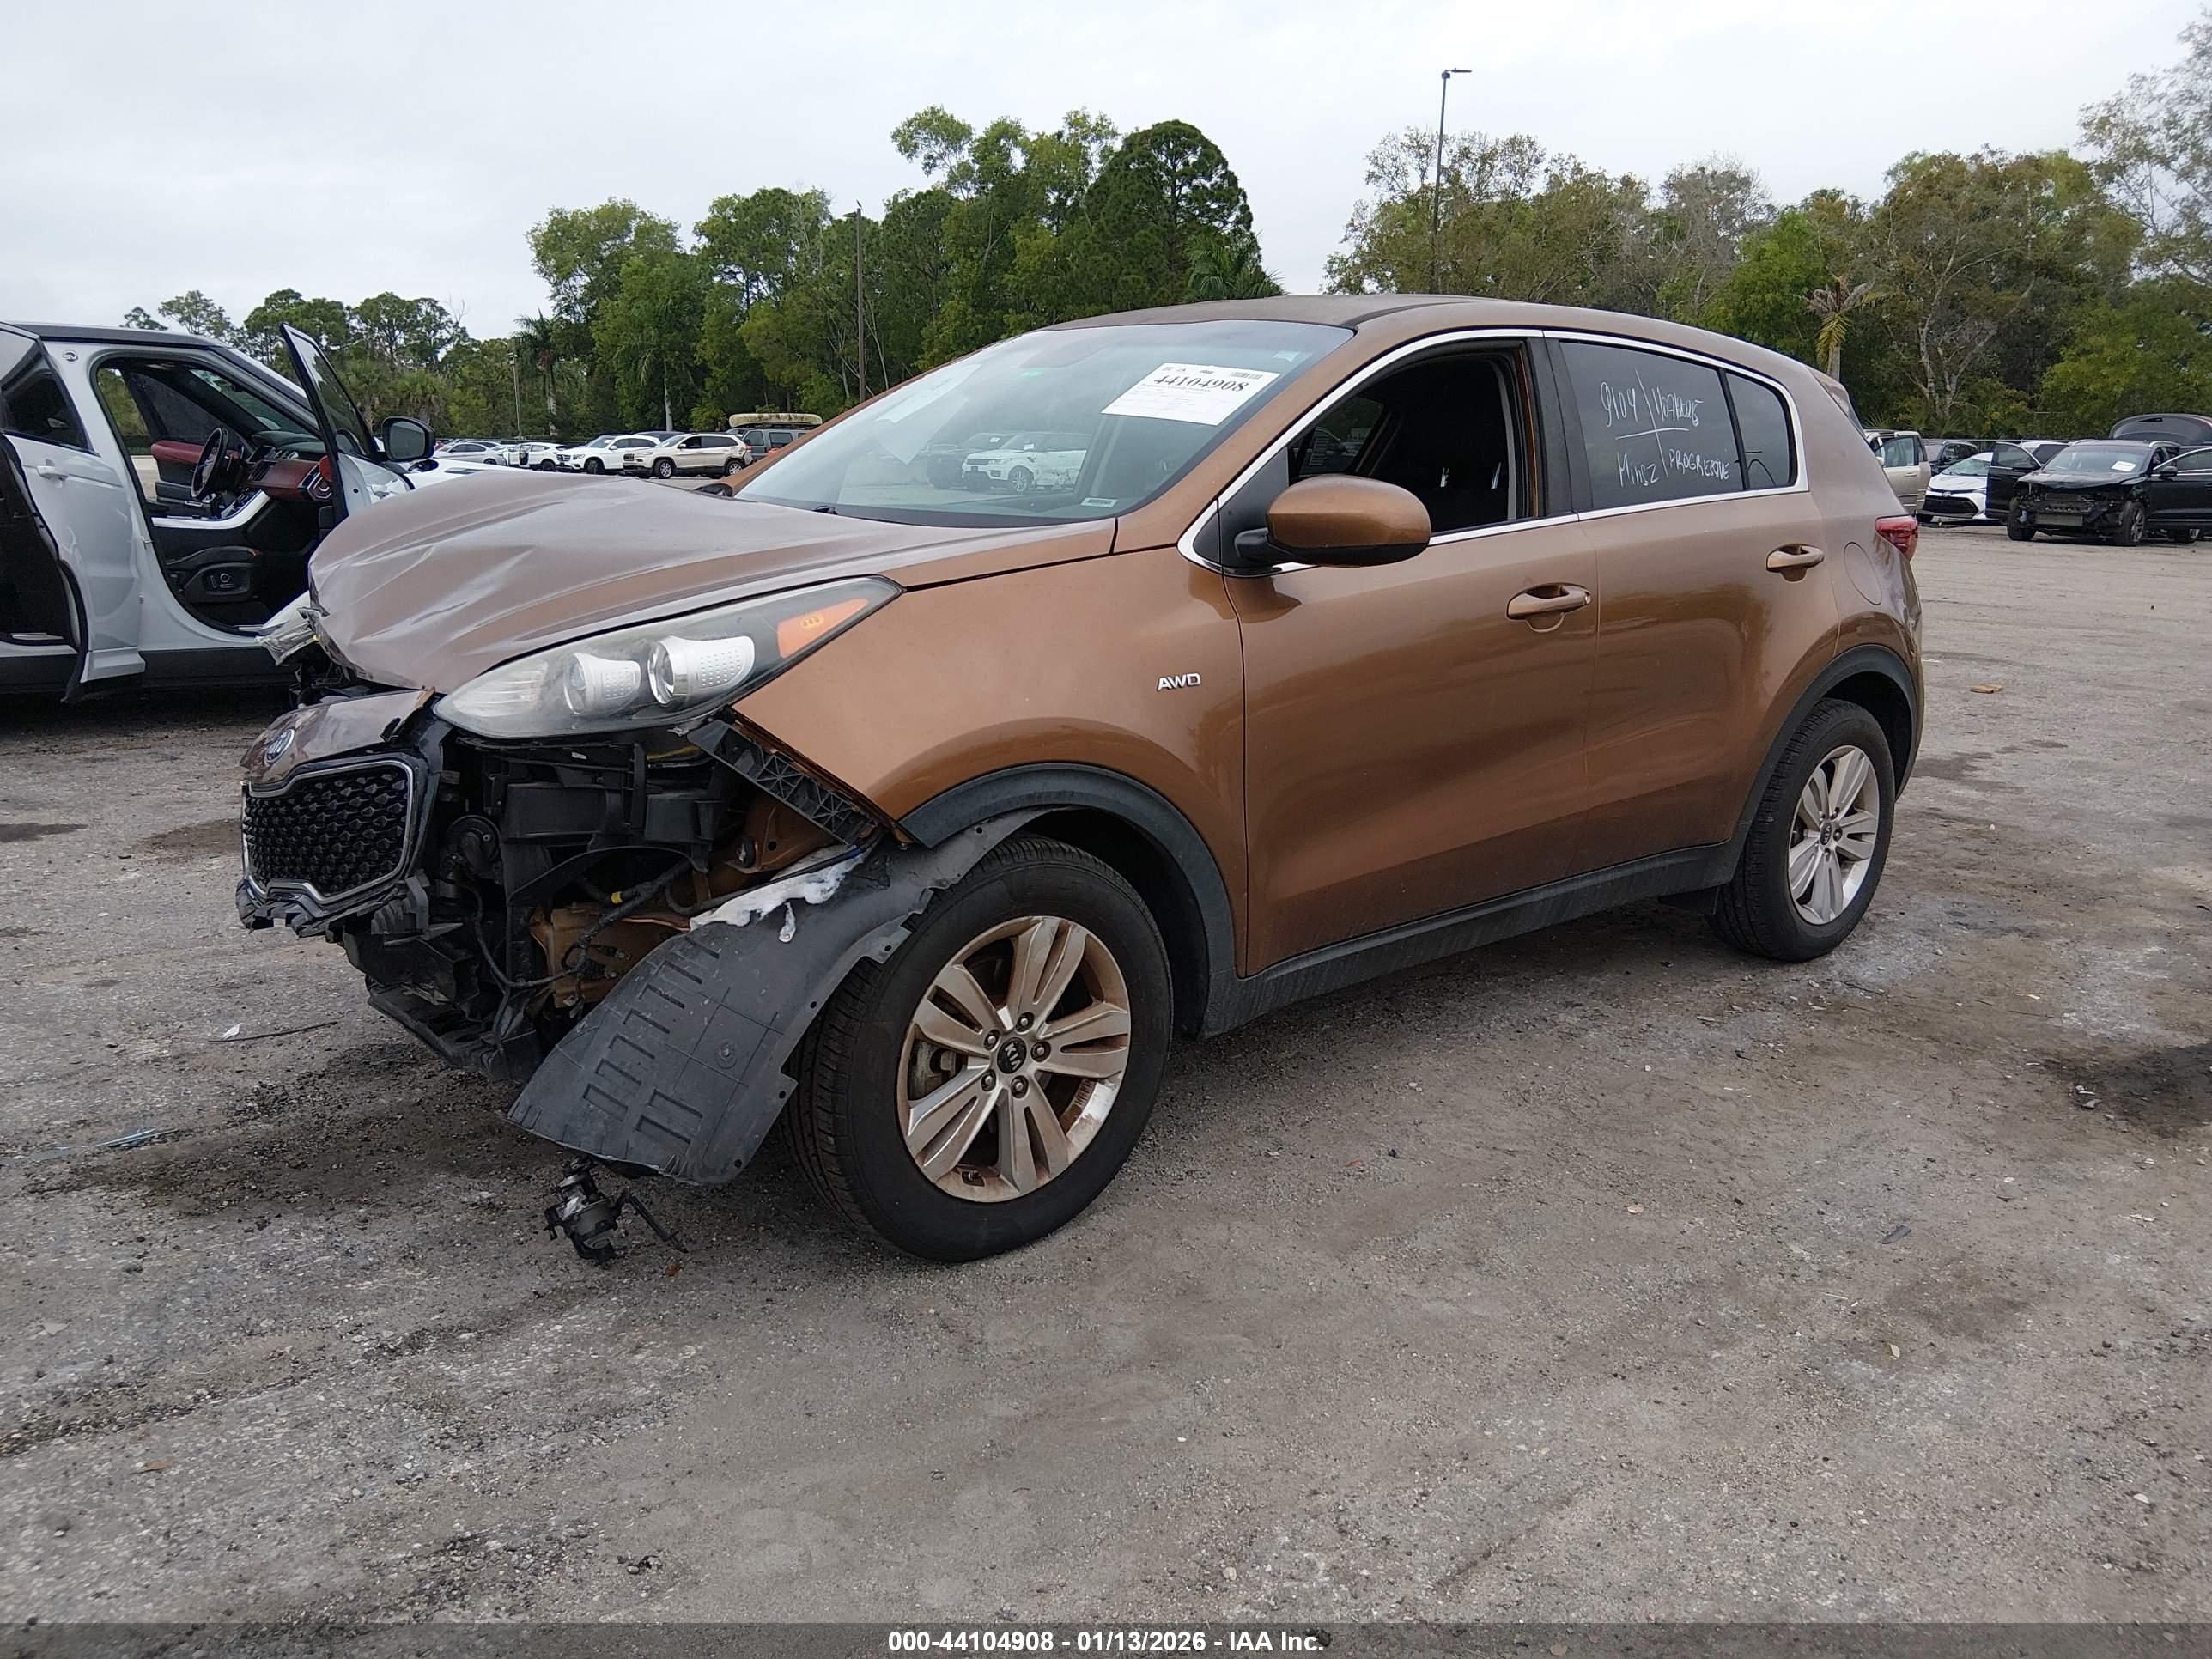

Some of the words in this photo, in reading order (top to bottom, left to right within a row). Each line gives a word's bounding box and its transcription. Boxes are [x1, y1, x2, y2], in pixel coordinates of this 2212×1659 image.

[1153, 374, 1249, 392] 44104908
[1157, 672, 1201, 691] AWD
[1004, 1042, 1022, 1072] KIA
